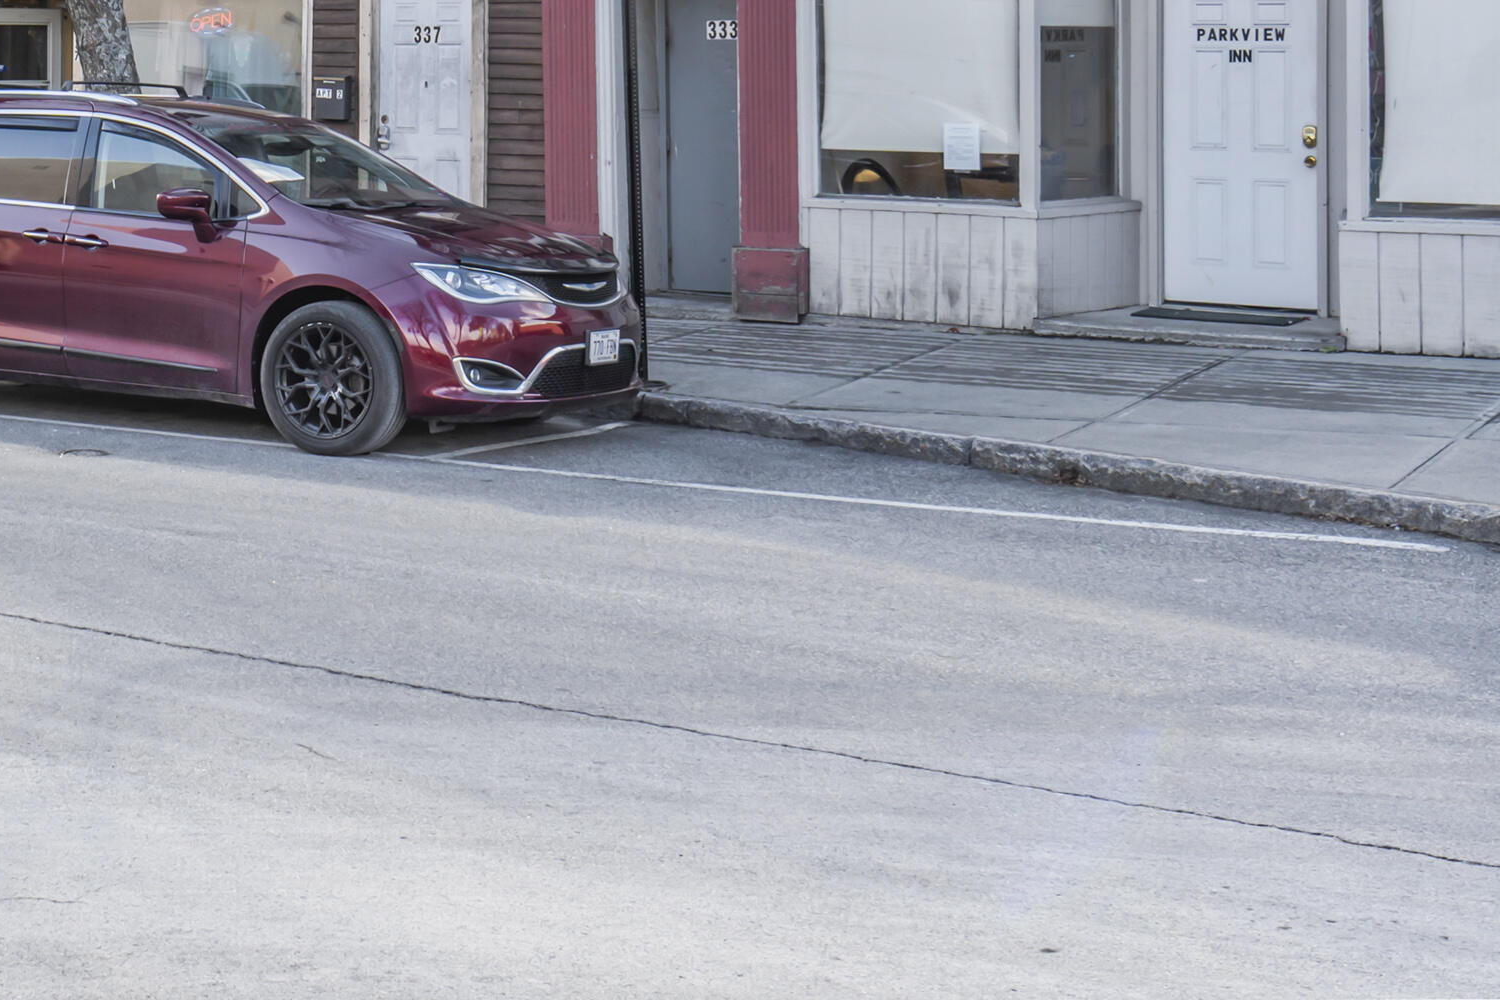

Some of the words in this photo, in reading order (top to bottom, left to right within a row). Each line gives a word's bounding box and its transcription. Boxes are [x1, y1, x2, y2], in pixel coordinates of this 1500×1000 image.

[190, 11, 232, 32] OPEN
[414, 26, 441, 43] 337
[708, 21, 737, 38] 333
[1197, 28, 1285, 42] PARKVIEW
[1228, 50, 1252, 63] INN
[316, 89, 331, 98] APT
